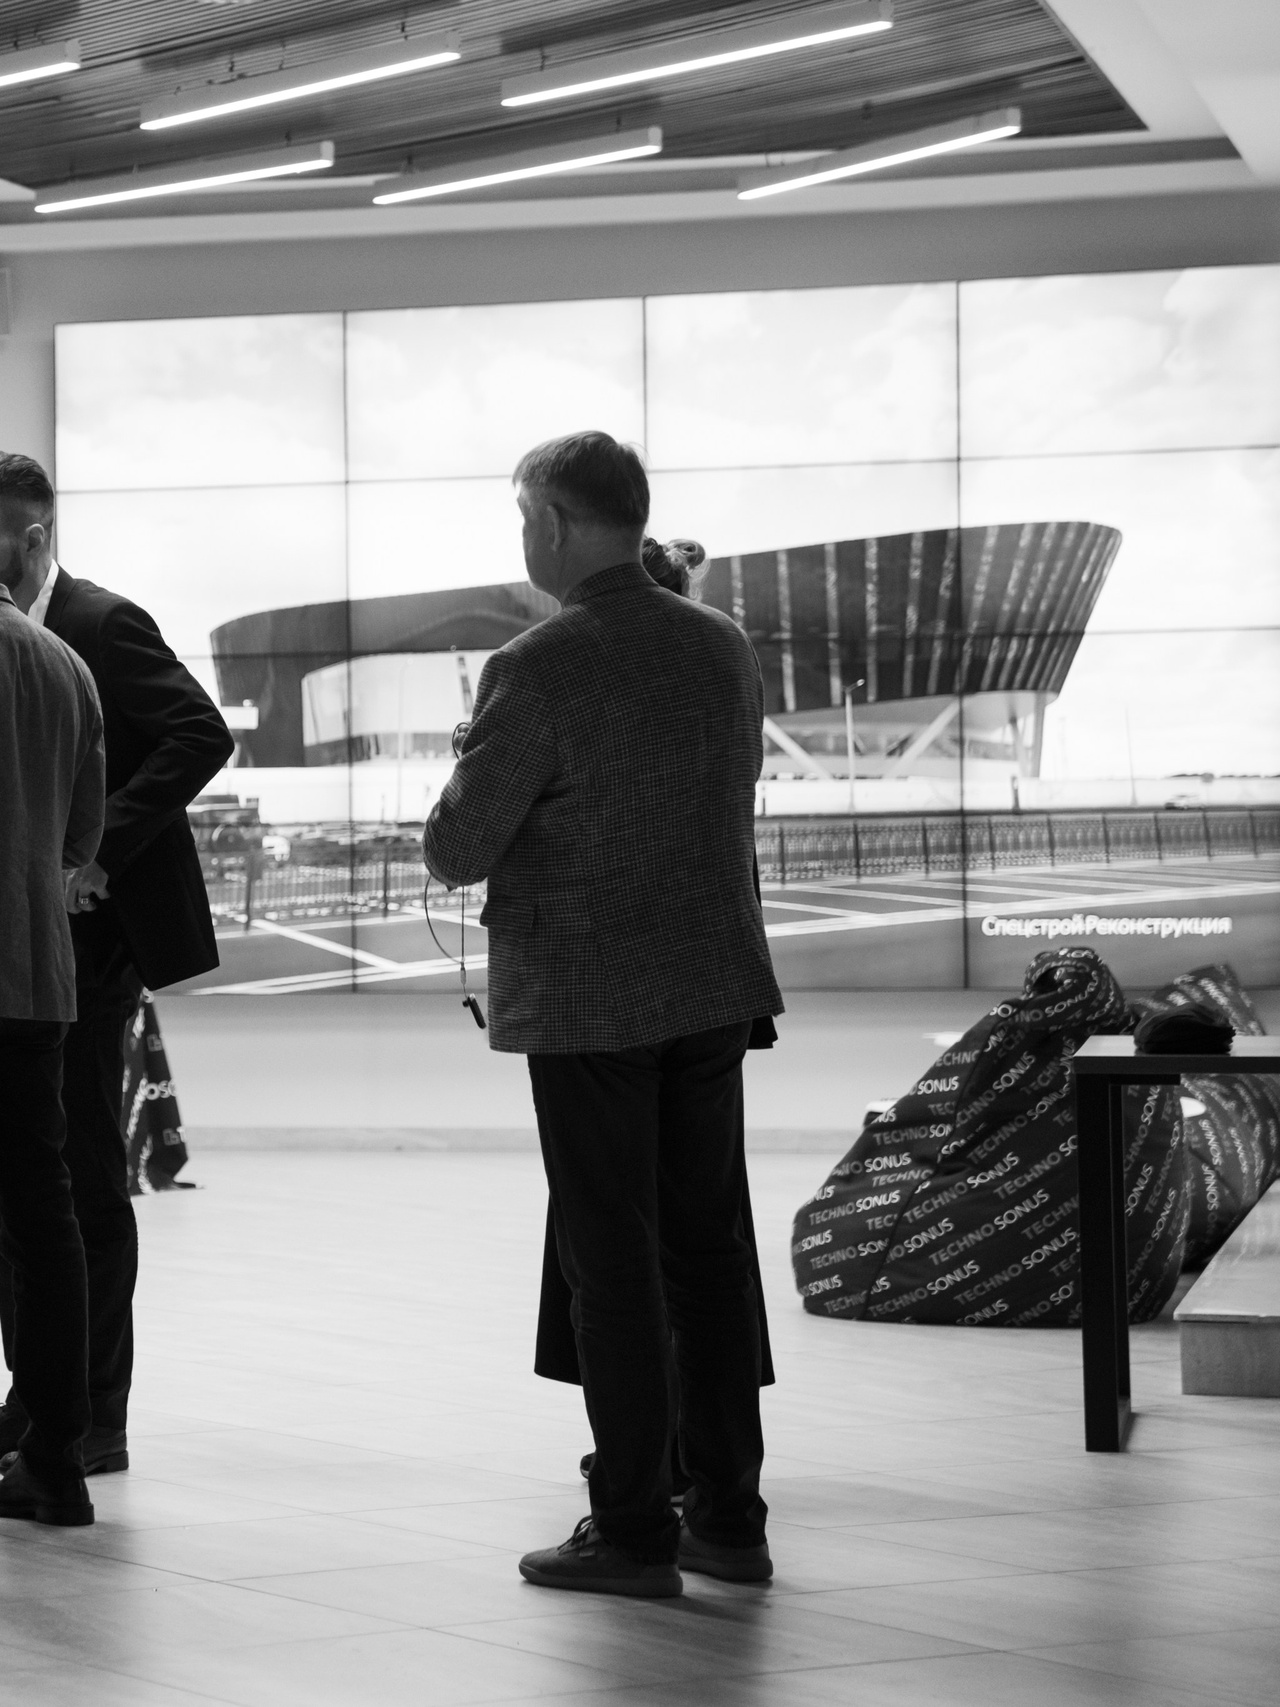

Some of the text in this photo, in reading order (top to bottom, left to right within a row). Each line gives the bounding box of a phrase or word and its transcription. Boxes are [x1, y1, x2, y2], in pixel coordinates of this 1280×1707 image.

[917, 1076, 959, 1095] SONUS
[993, 1051, 1036, 1093] SONUS
[864, 1152, 911, 1173] SONUS
[967, 1151, 1020, 1189] SONUS
[993, 1152, 1061, 1199] TECHNO
[855, 1189, 901, 1212] SONUS
[904, 1217, 955, 1254] SONUS
[928, 1223, 995, 1266] TECHNO
[993, 1188, 1050, 1230] SONUS
[926, 1260, 981, 1295] SONUS
[953, 1263, 1022, 1305] TECHNO
[1021, 1227, 1077, 1270] SONUS
